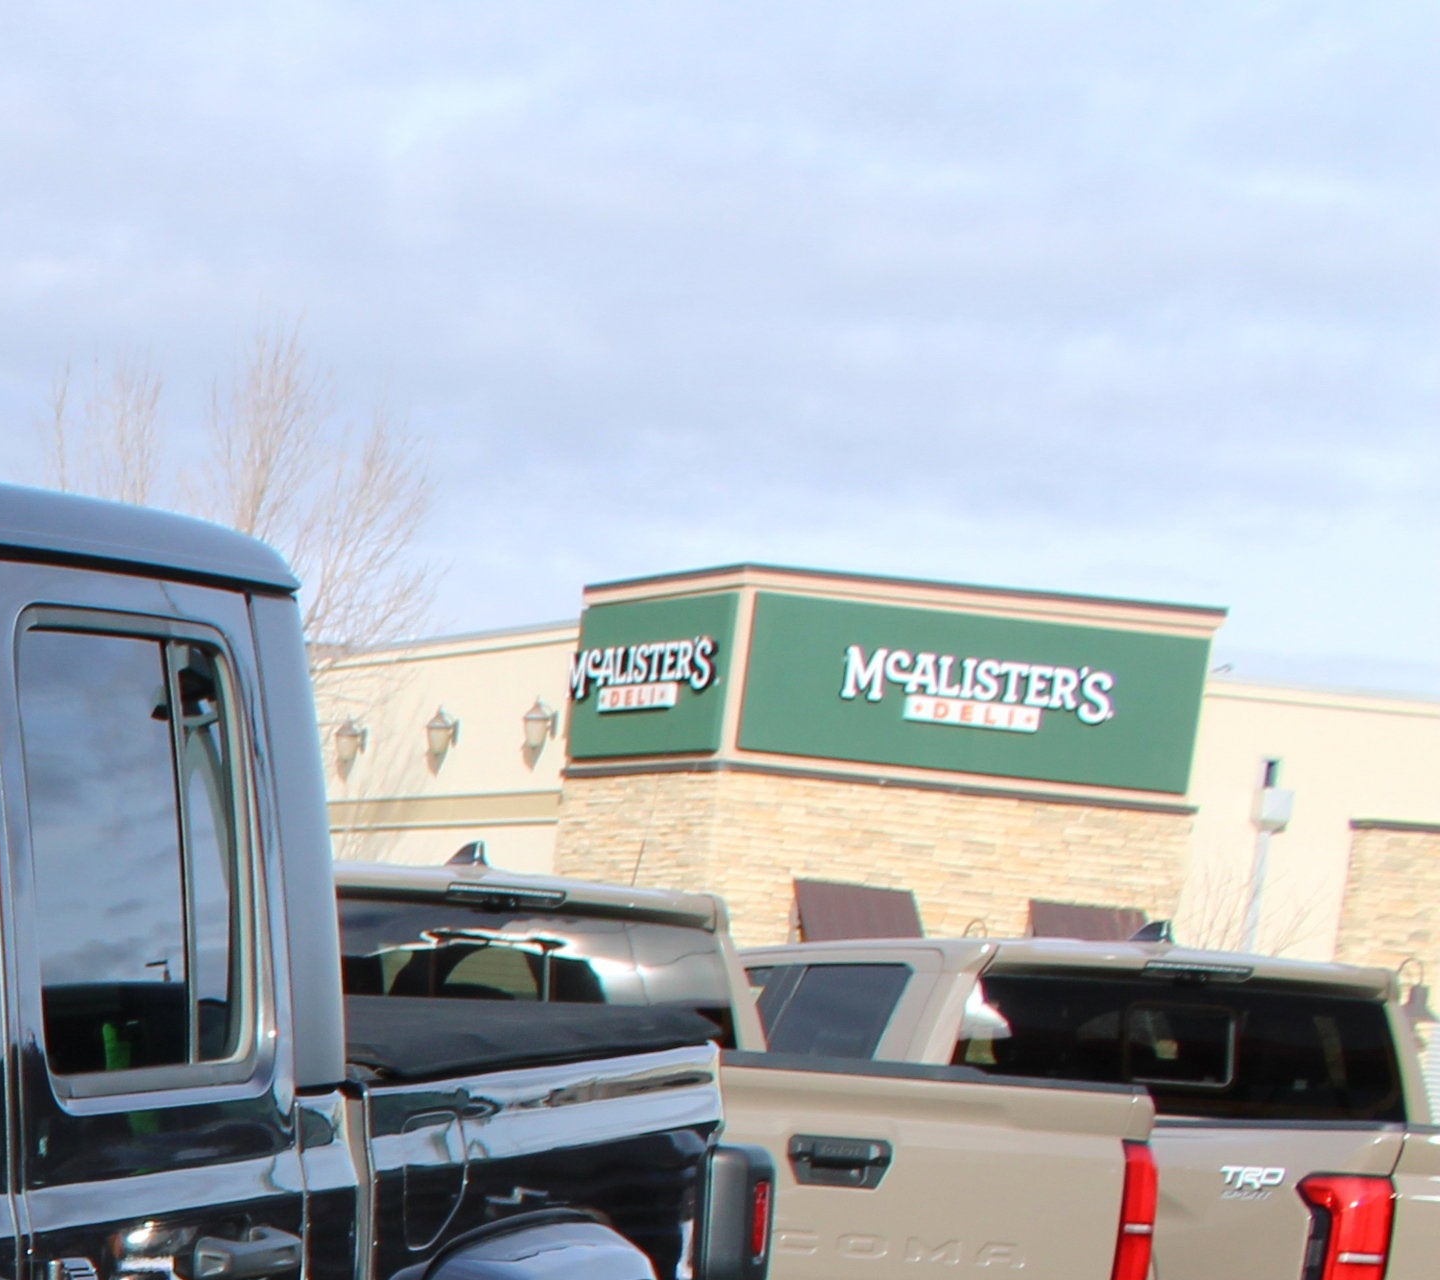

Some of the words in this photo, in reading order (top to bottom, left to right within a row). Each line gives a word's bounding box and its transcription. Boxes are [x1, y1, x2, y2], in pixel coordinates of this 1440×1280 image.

[609, 687, 656, 707] DELI
[933, 702, 1015, 726] DELI
[1219, 1165, 1286, 1190] TRD
[774, 1229, 1025, 1269] COMA
